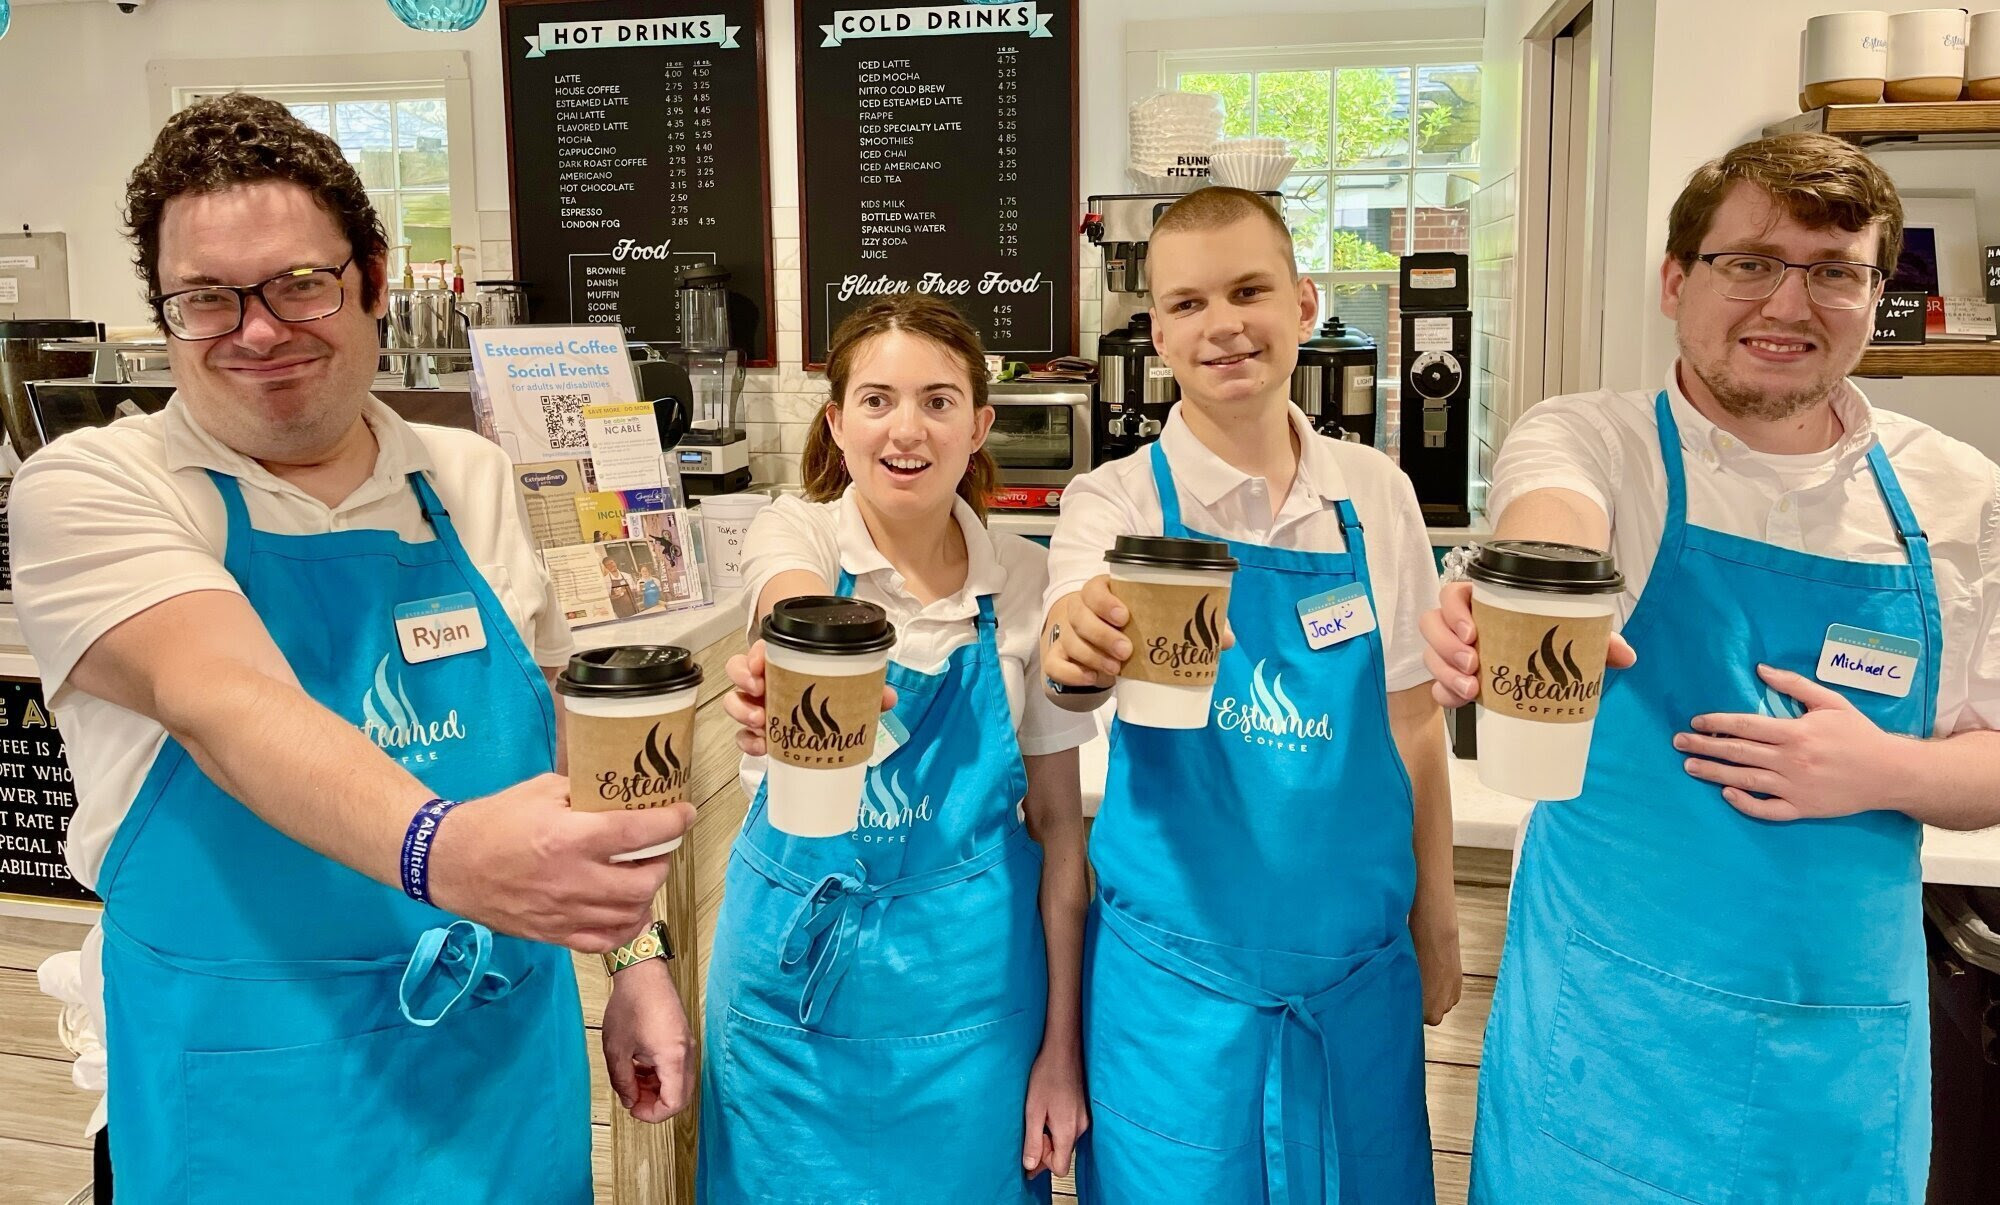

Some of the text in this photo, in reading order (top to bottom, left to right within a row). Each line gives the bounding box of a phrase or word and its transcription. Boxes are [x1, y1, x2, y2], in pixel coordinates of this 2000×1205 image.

[842, 7, 1029, 33] COLD DRINKS
[555, 21, 711, 44] HOT DRINKS
[859, 56, 1016, 69] ICED LATTE 4.75
[555, 68, 709, 84] LATTE 4.00 4.50
[859, 69, 1016, 82] ICED MOCHA 5.25
[555, 81, 710, 95] HOUSE COFFEE 2.75 3.25
[859, 82, 1016, 95] NITRO COLD BREW 4.75
[556, 93, 710, 108] ESTEAMED LATTE 4.35 4.85
[860, 99, 880, 108] ICED
[884, 98, 932, 106] ESTEAMED
[934, 97, 963, 105] LATTE
[557, 106, 710, 120] CHAI LATTE 3.95 4.45
[860, 112, 893, 120] FRAPPE
[557, 118, 711, 132] FLAVORED LATTE 4.35 4.85
[860, 122, 1016, 133] ICED SPECIALTY LATTE 5.25
[558, 131, 712, 144] MOCHA 4.75 5.25
[860, 134, 1016, 145] SMOOTHIES 4.85
[559, 143, 712, 156] CAPPUCCINO 3.90 4.40
[861, 150, 881, 158] ICED
[998, 147, 1016, 155] 4.50
[559, 156, 713, 168] DARK ROAST COFFEE 2.75 3.25
[861, 160, 1016, 171] ICED AMERICANO 3.25
[560, 168, 714, 180] AMERICANO 2.75 3.25
[861, 173, 1017, 183] ICED TEA 2.50
[560, 180, 714, 192] HOT CHOCOLATE 3.15 3.65
[561, 194, 687, 205] TEA 2.50
[861, 201, 880, 209] KIDS
[883, 200, 905, 208] MILK
[561, 208, 602, 216] ESPRESSO
[861, 210, 1018, 221] BOTTLED WATER 2.00
[562, 217, 715, 228] LONDON FOG 3.85 4.35
[862, 225, 911, 234] SPARKLING
[1000, 223, 1018, 231] 2.50
[862, 238, 880, 246] IZZY
[999, 236, 1018, 244] 2.25
[612, 239, 671, 261] Food
[861, 249, 1017, 259] JUICE 1.75
[587, 267, 626, 275] BROWNIE
[587, 279, 618, 287] DANISH
[838, 271, 1041, 301] Gluten Free Food
[588, 291, 619, 299] MUFFIN
[588, 303, 617, 311] SCONE
[993, 305, 1011, 314] 4.25
[1886, 310, 1914, 318] ART
[994, 318, 1011, 326] 3.75
[993, 330, 1011, 338] 3.75
[485, 340, 618, 357] Esteamed Coffee
[508, 364, 609, 378] Social Events
[512, 380, 610, 391] for adults w/disabilities
[605, 426, 619, 435] NC
[718, 526, 737, 534] Take
[1309, 619, 1346, 638] Jack
[413, 625, 469, 649] Ryan
[1831, 653, 1901, 679] Michael C
[1516, 703, 1585, 715] COFFEE
[769, 717, 867, 751] Esteamed
[36, 742, 49, 756] IS
[1245, 735, 1308, 752] COFFEE
[784, 751, 844, 763] COFFEE
[32, 766, 73, 782] WHO
[43, 790, 72, 807] THE
[15, 812, 54, 829] RATE
[411, 816, 435, 884] Abilities
[0, 859, 72, 879] ABILITIES
